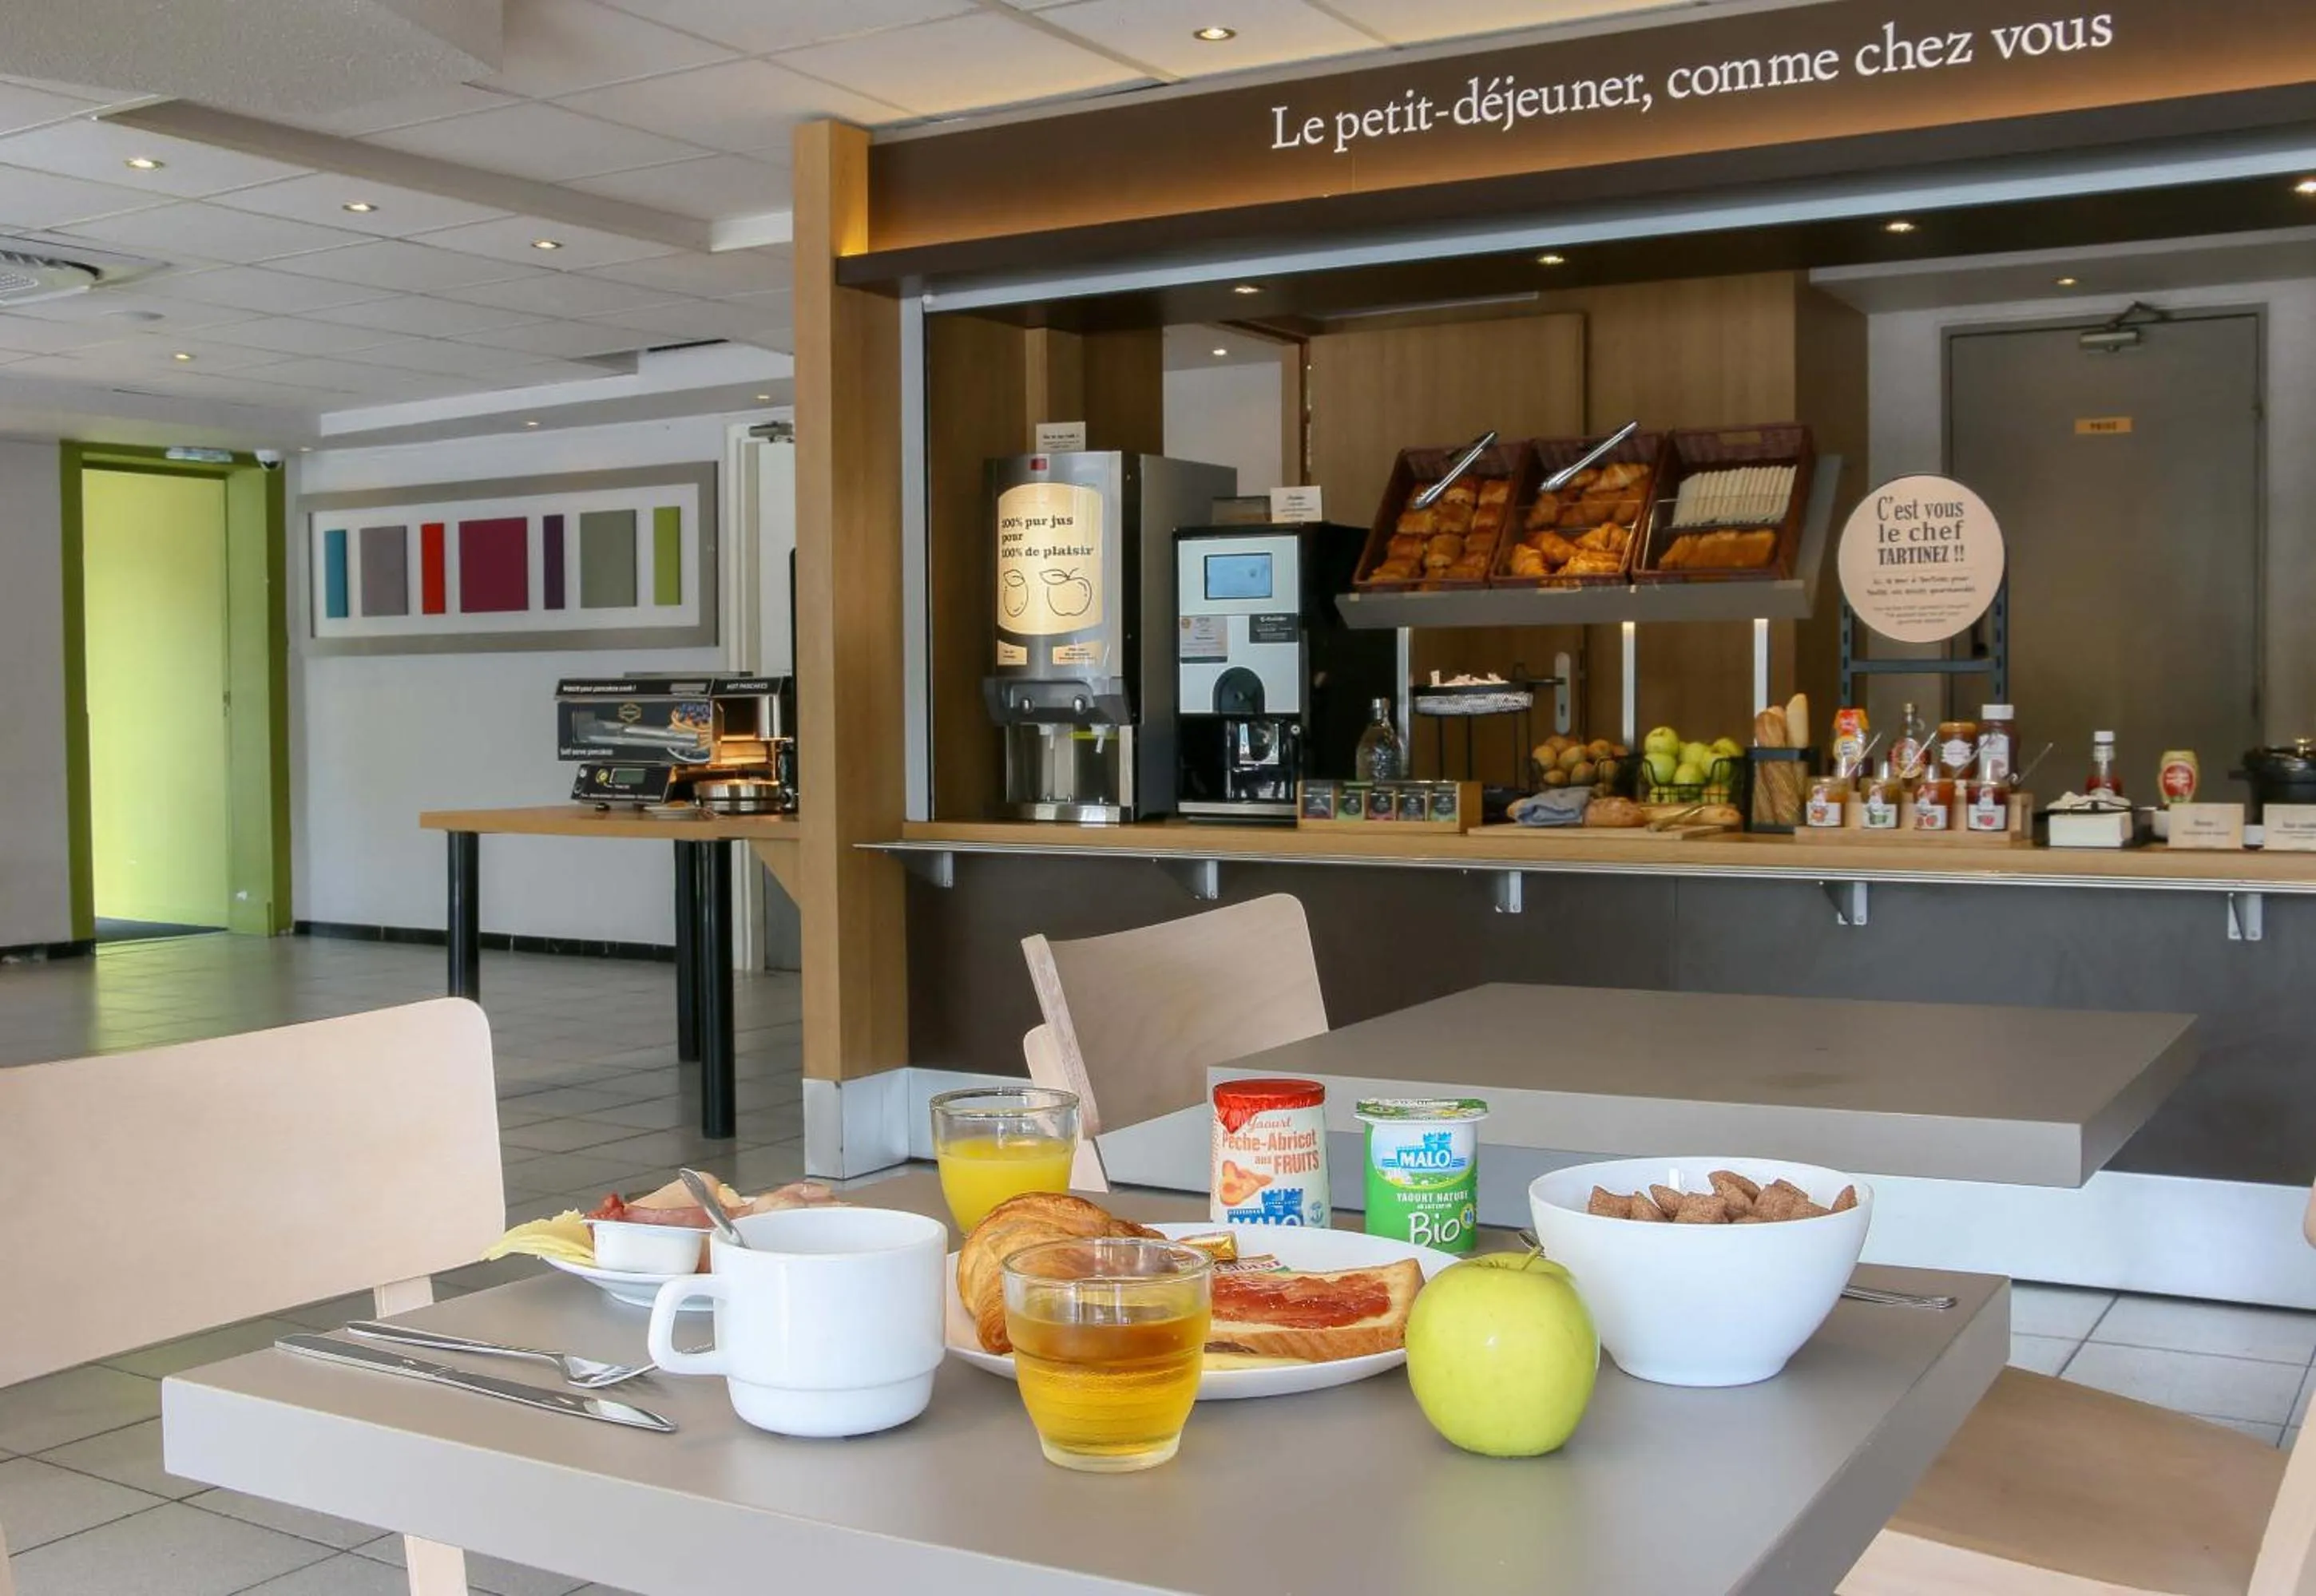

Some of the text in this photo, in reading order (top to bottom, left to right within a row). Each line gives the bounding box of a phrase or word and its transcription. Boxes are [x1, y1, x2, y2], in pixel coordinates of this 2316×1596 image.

[1271, 13, 2114, 153] Le petit-déjeuner, comme chez vous
[1877, 496, 1965, 521] C'est vous
[1025, 517, 1048, 530] pur
[1049, 513, 1074, 529] jus
[1878, 520, 1965, 543] le chef
[1001, 533, 1024, 545] pour
[1025, 546, 1040, 557] de
[1042, 545, 1094, 560] plaisir
[1878, 545, 1949, 566] TARTINEZ
[1274, 1150, 1319, 1174] FRUITS
[1401, 1150, 1451, 1168] MALO
[1408, 1211, 1461, 1246] Bio
